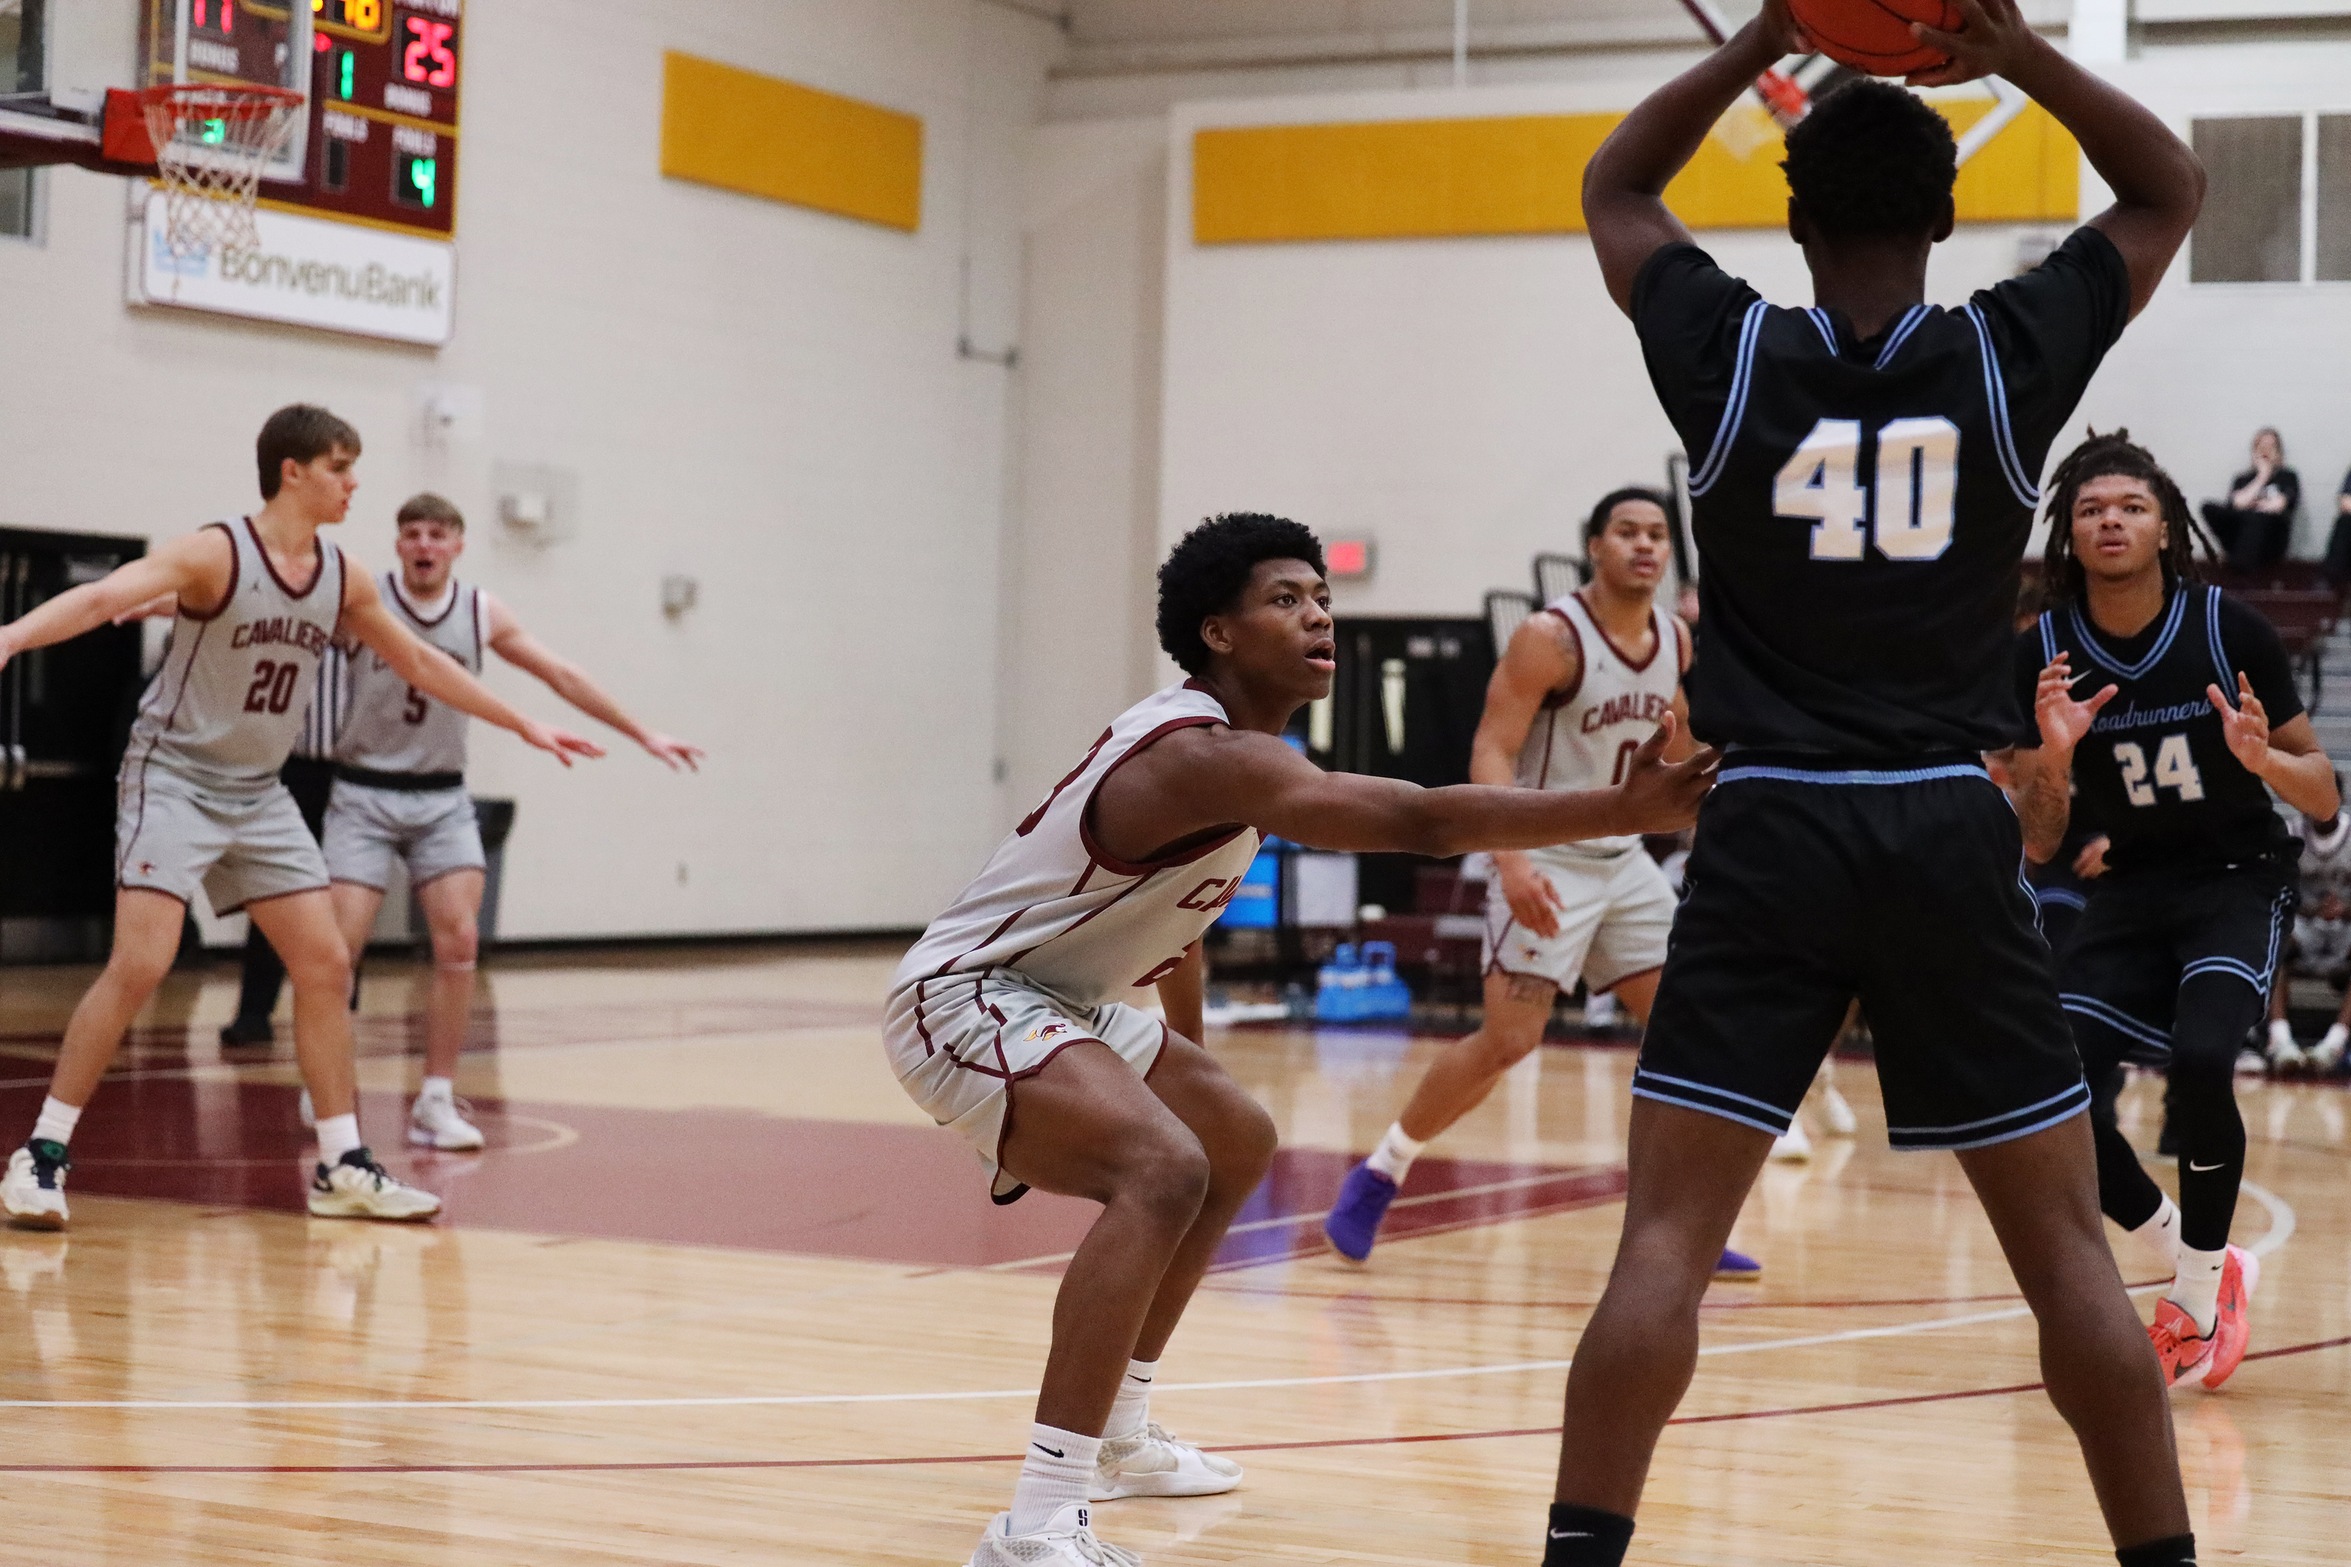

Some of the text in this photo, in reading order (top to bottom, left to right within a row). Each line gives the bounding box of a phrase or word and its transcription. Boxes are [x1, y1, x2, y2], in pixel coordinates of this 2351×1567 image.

[340, 50, 354, 101] 1
[404, 16, 456, 88] 25
[411, 157, 437, 209] 4
[1772, 415, 1961, 561] 40
[243, 659, 300, 715] 20
[2090, 700, 2215, 734] oadrunners
[2112, 732, 2205, 807] 24
